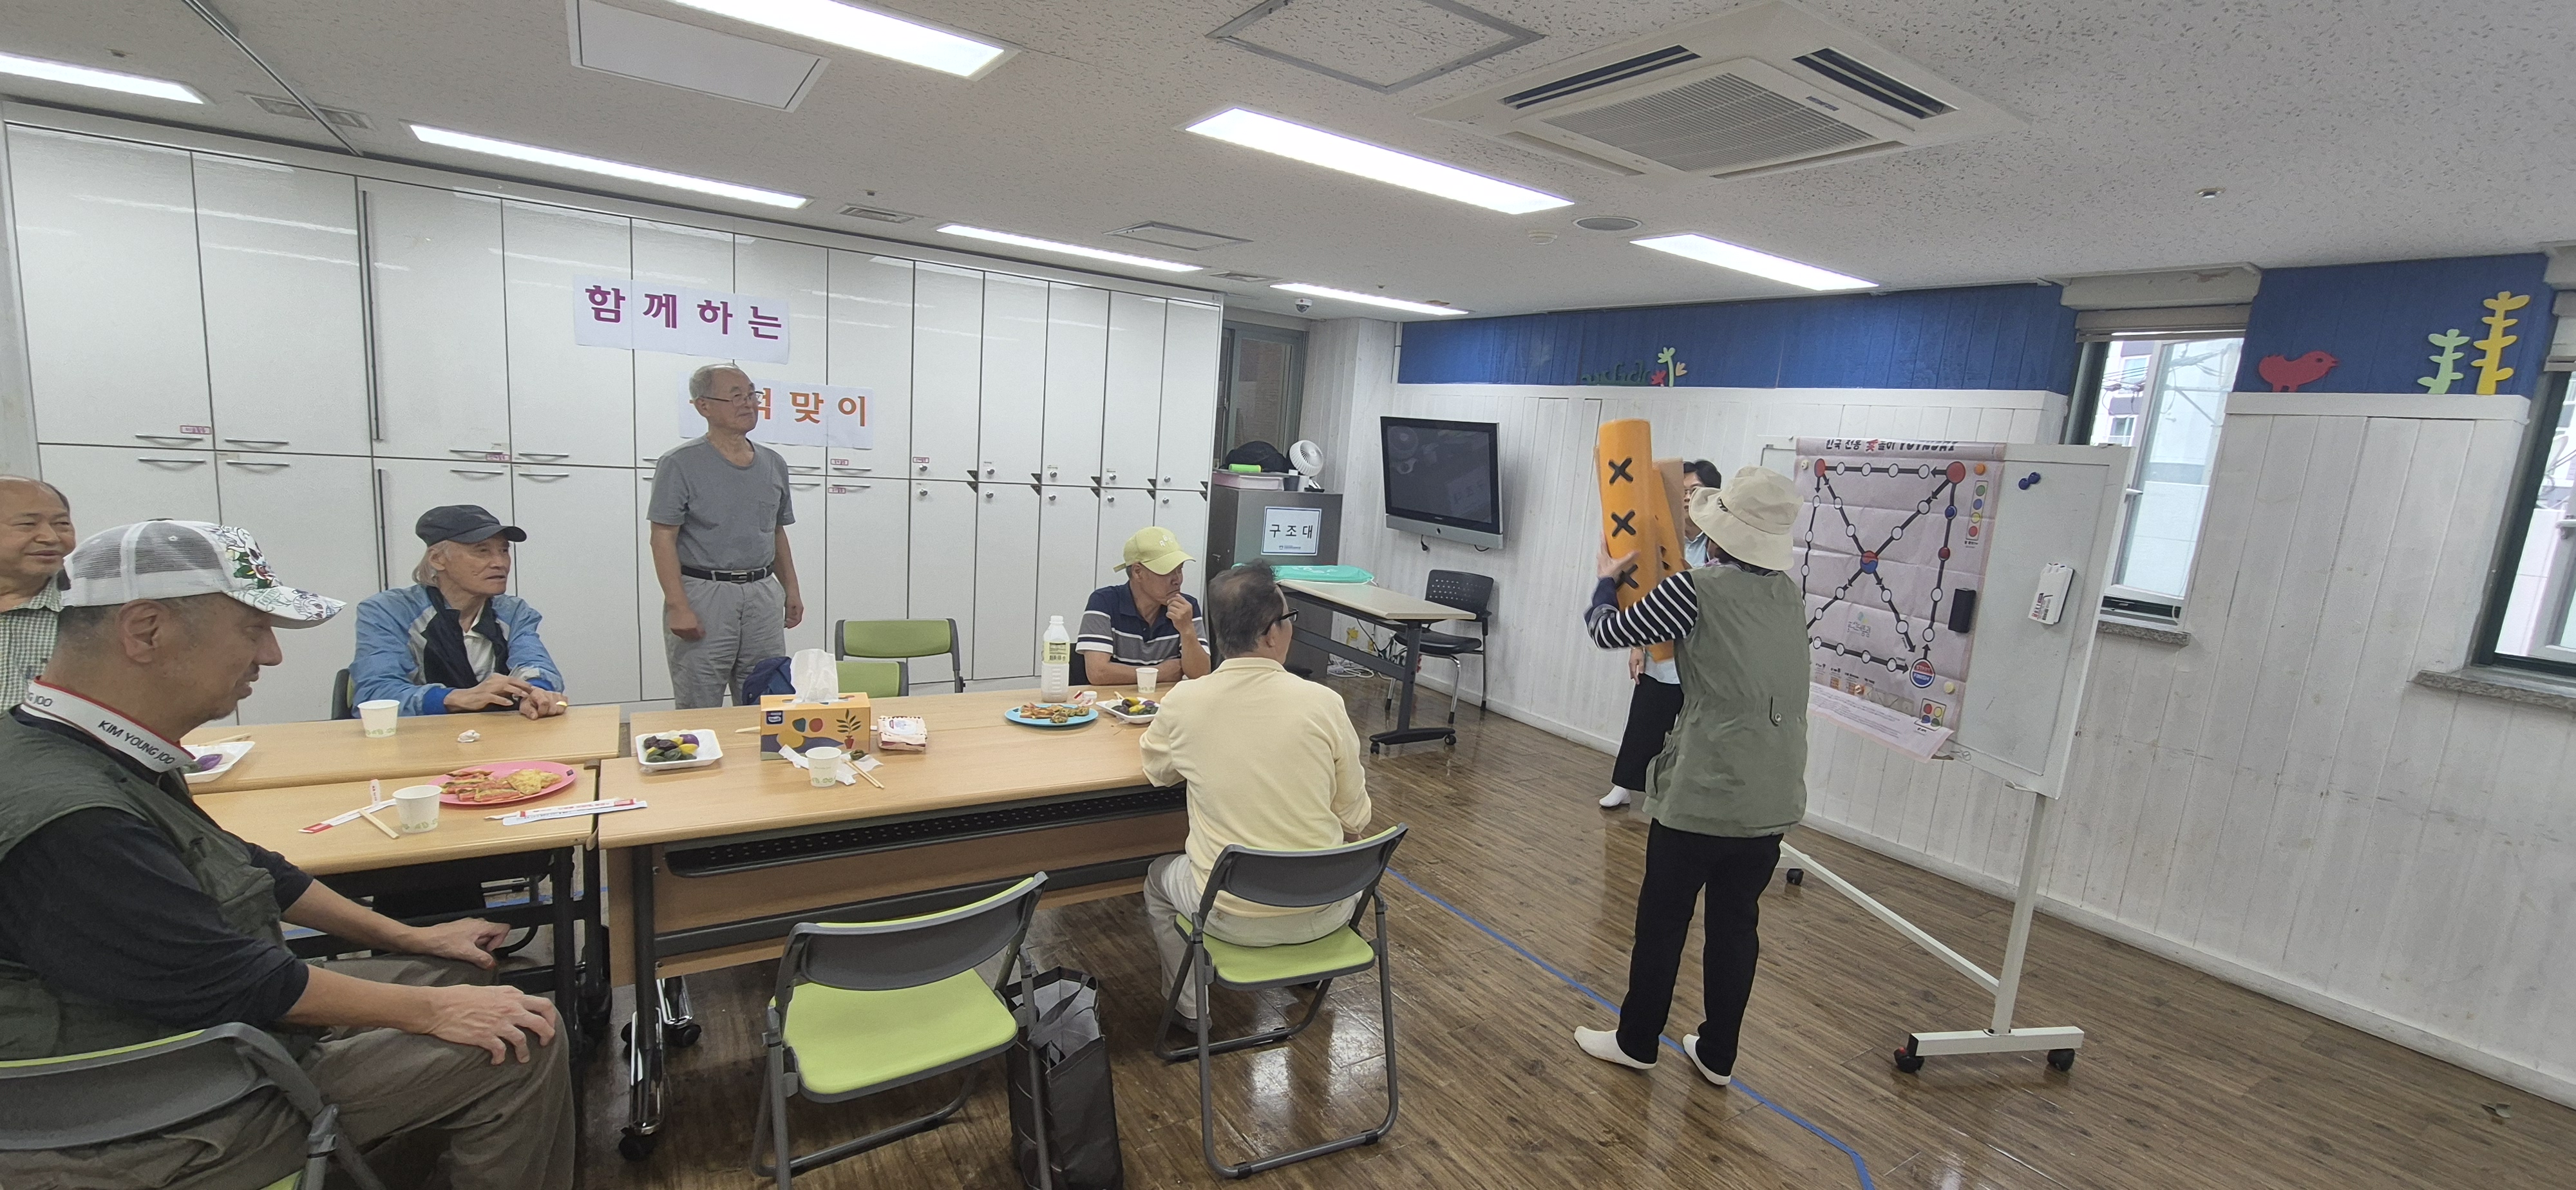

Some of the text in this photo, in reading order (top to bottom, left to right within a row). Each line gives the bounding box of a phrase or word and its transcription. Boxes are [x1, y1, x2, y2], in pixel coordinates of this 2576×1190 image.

[585, 285, 782, 340] 함께하는
[790, 392, 866, 428] 맞이
[1269, 524, 1313, 539] 구조대
[33, 695, 53, 707] JOO
[98, 719, 176, 765] KIM YOUNG JOO
